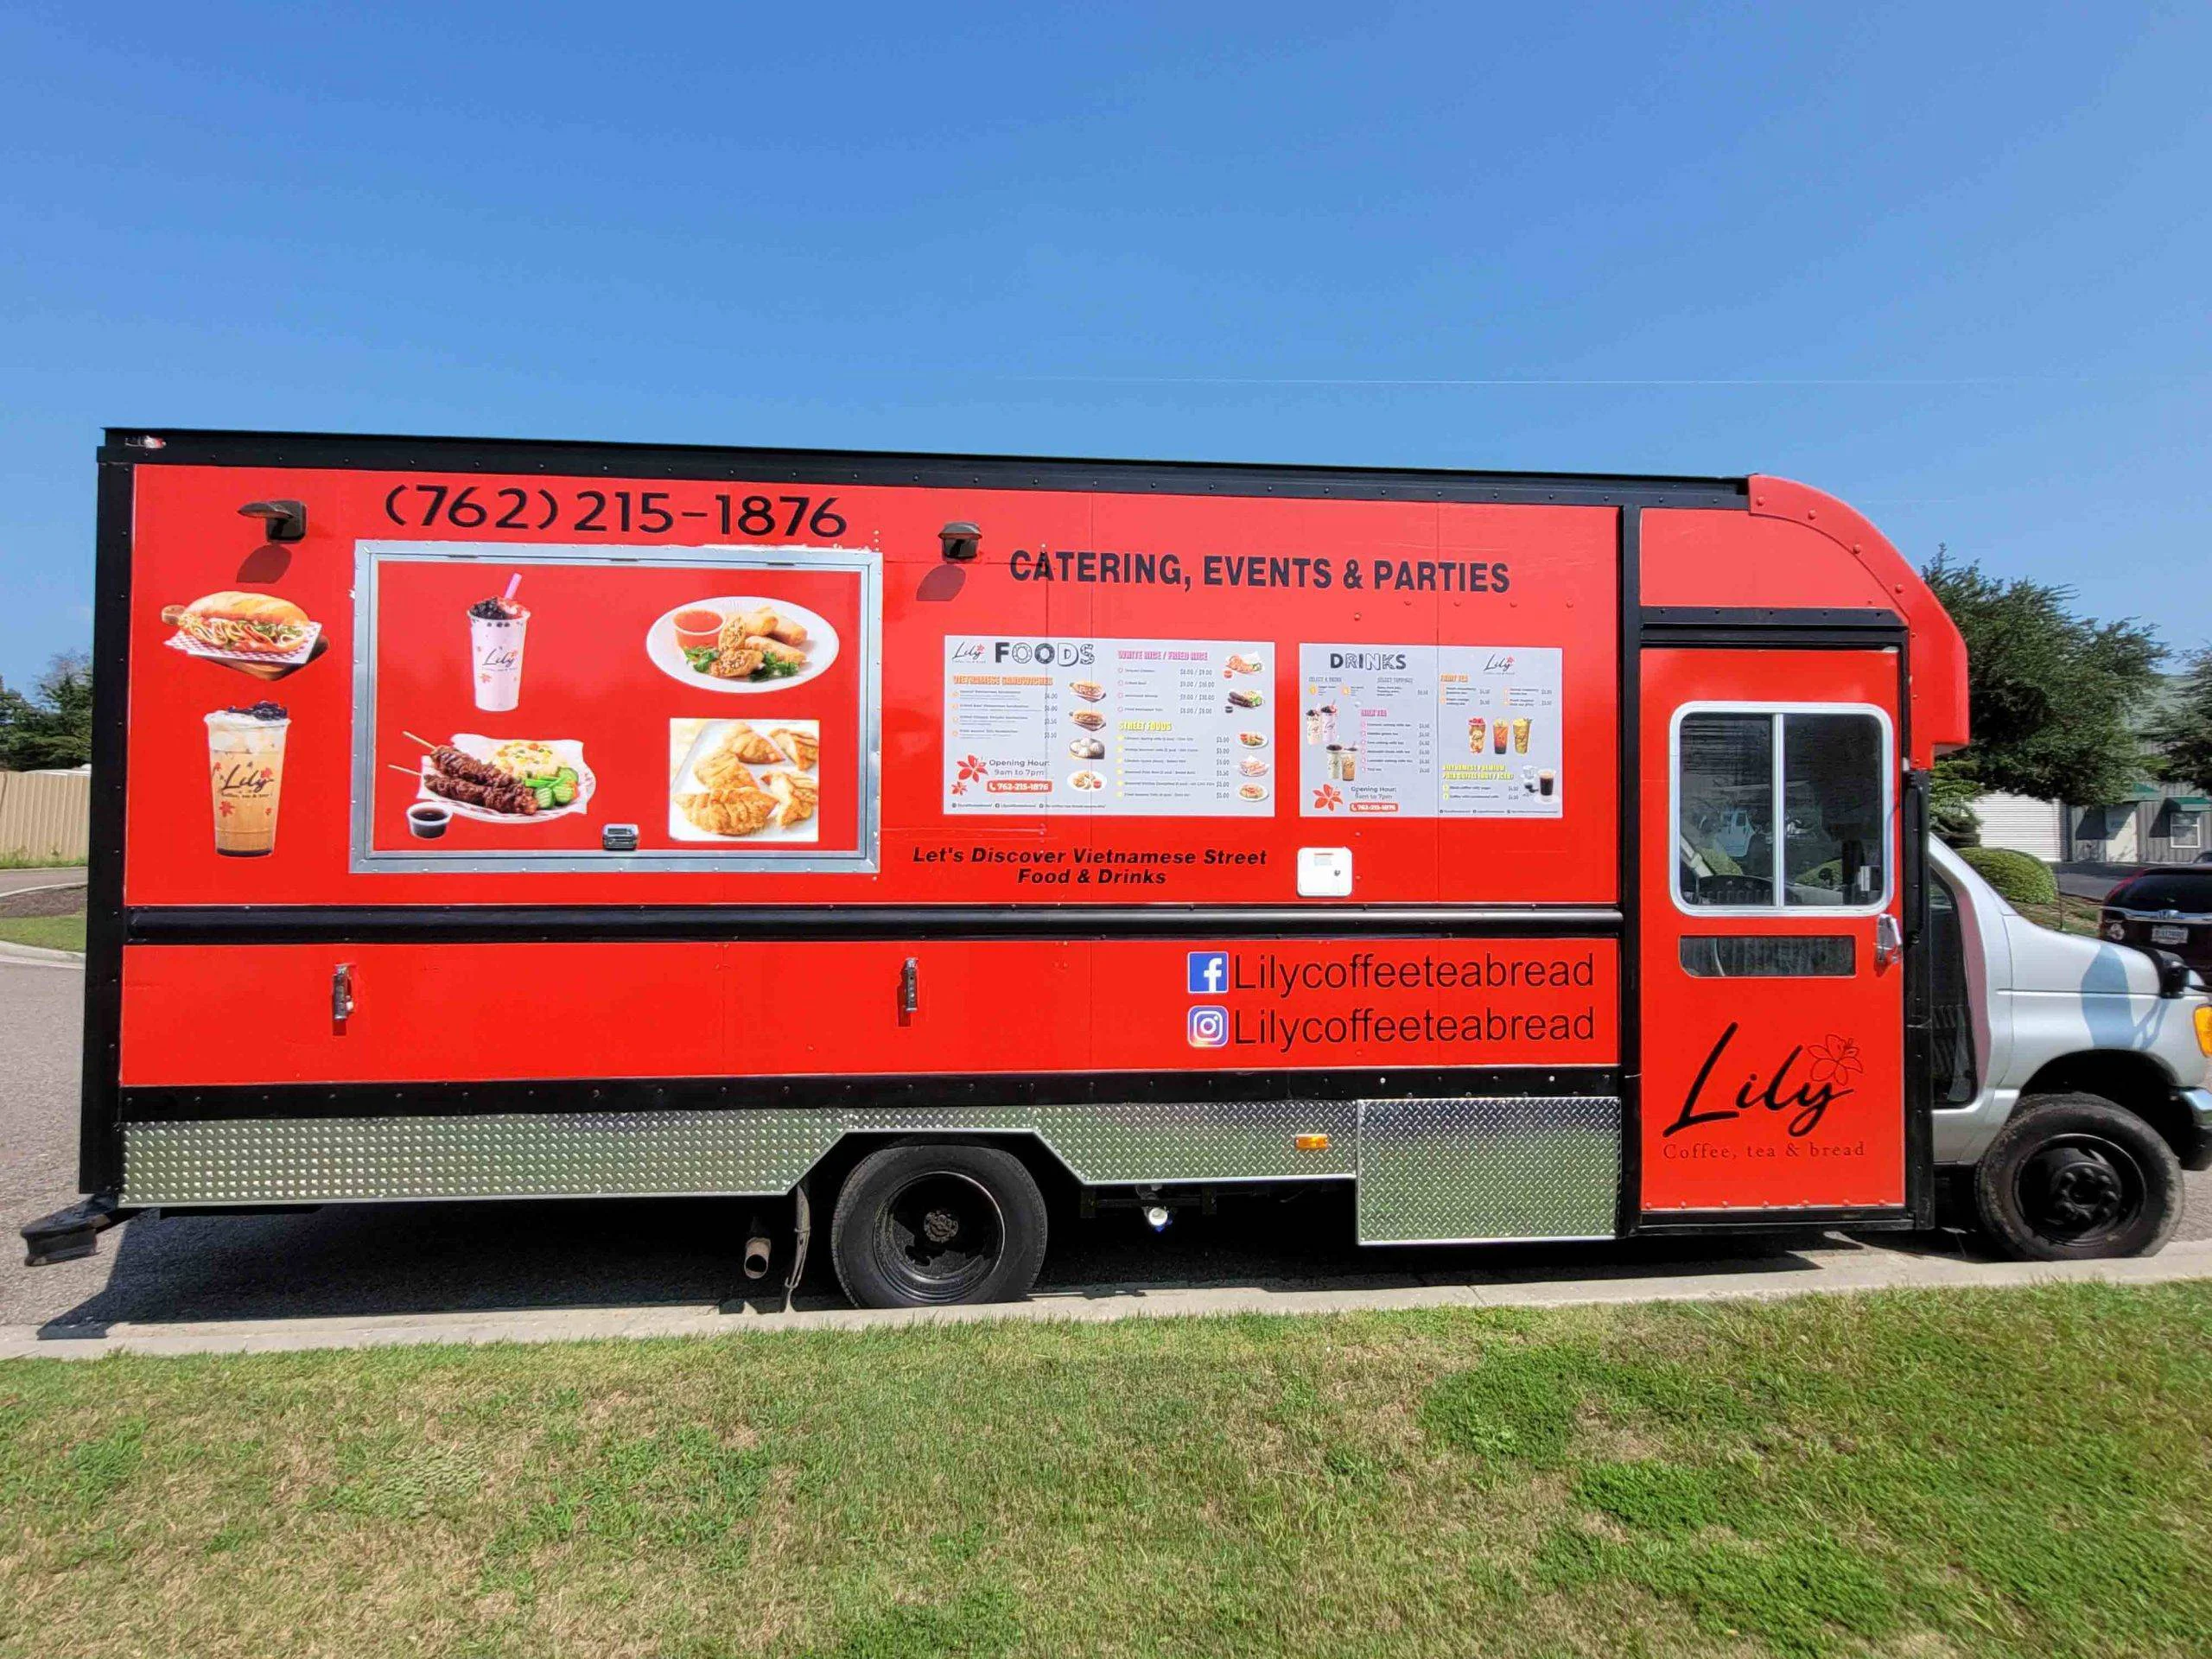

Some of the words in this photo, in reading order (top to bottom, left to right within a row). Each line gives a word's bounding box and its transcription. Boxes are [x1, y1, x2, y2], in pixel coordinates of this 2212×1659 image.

[1009, 550, 1191, 592] CATERING,
[1204, 556, 1332, 589] EVENTS
[1343, 559, 1363, 589] &
[1374, 560, 1510, 593] PARTIES
[995, 642, 1096, 667] FOODS
[1330, 652, 1407, 671] DRINKS
[988, 759, 1026, 768] Opening
[221, 764, 275, 793] Lily
[1351, 785, 1378, 794] Opening
[912, 847, 963, 864] Let's
[971, 848, 1066, 865] Discover
[1073, 849, 1195, 865] Vietnamese
[1204, 849, 1267, 866] Street
[1017, 868, 1071, 885] Food
[1077, 869, 1091, 885] &
[1097, 869, 1166, 885] Drinks
[1234, 953, 1595, 999] Lilycoffeeteabread
[1234, 1007, 1595, 1053] Lilycoffeeteabread
[1662, 1021, 1854, 1137] Lily
[1662, 1142, 1737, 1160] Coffee,
[1747, 1145, 1776, 1158] tea
[1786, 1143, 1800, 1158] &
[1809, 1141, 1866, 1157] bread
